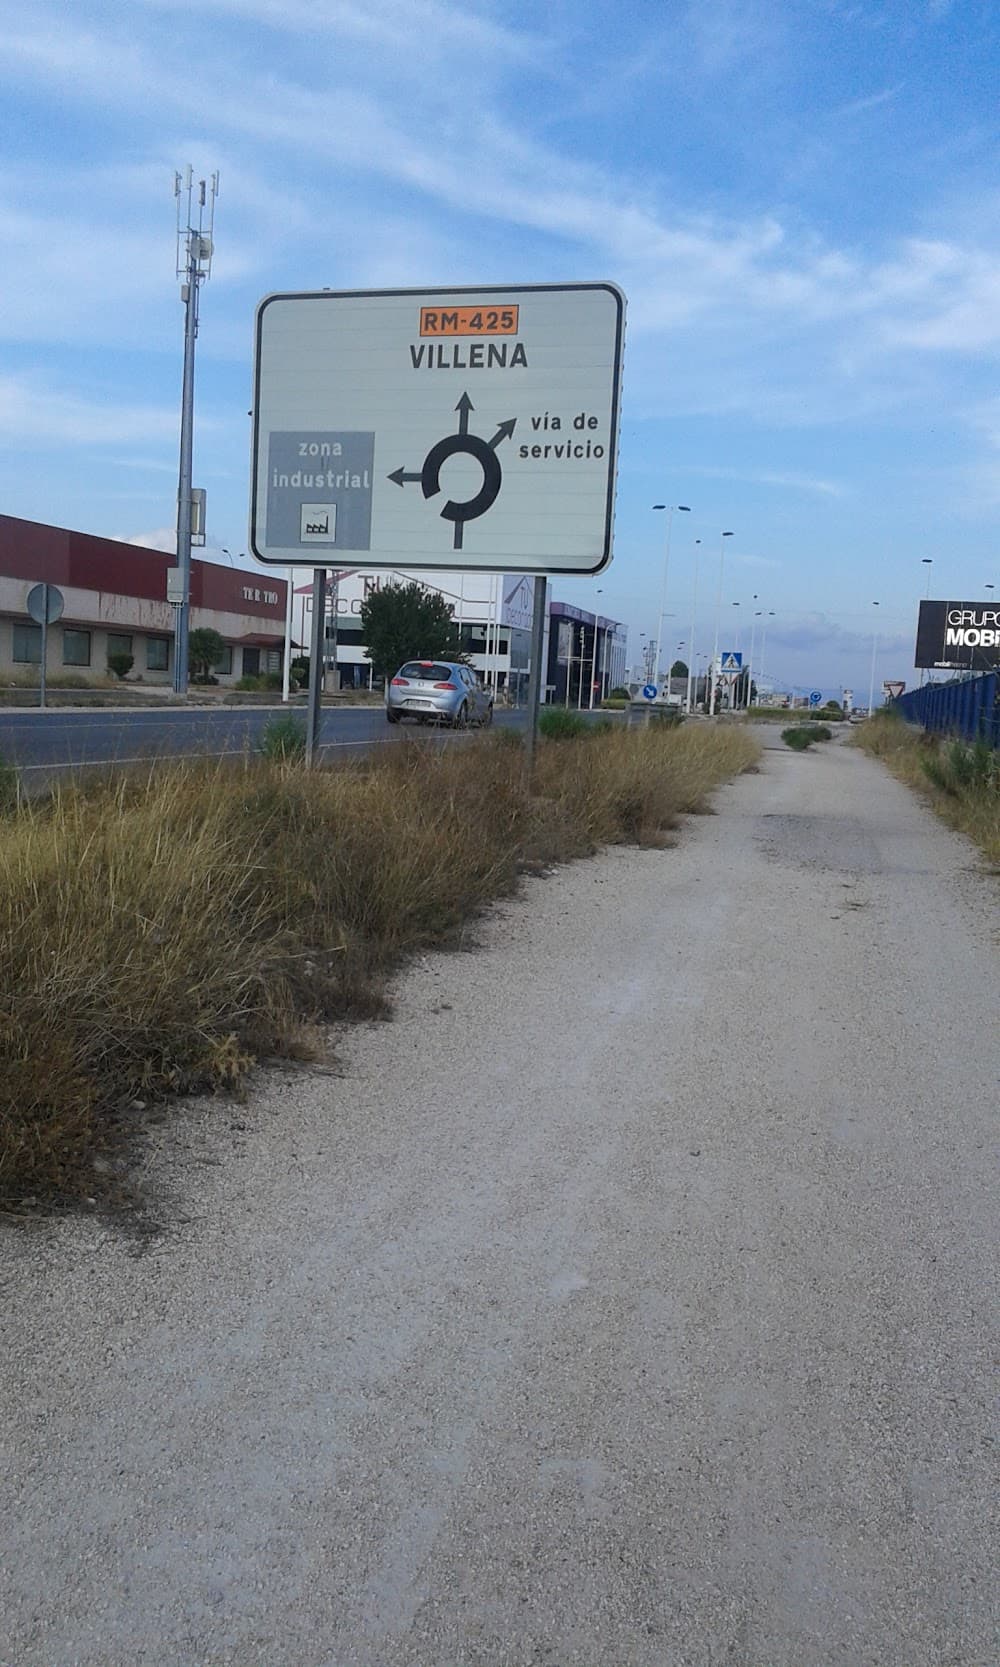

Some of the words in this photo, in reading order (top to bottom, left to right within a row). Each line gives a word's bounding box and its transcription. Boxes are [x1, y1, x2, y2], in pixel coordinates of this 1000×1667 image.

[424, 311, 514, 332] RM-425
[409, 343, 528, 369] VILLENA
[531, 412, 562, 431] vía
[573, 412, 598, 430] de
[298, 440, 343, 457] zona
[519, 441, 605, 459] servicio
[272, 469, 370, 488] industrial
